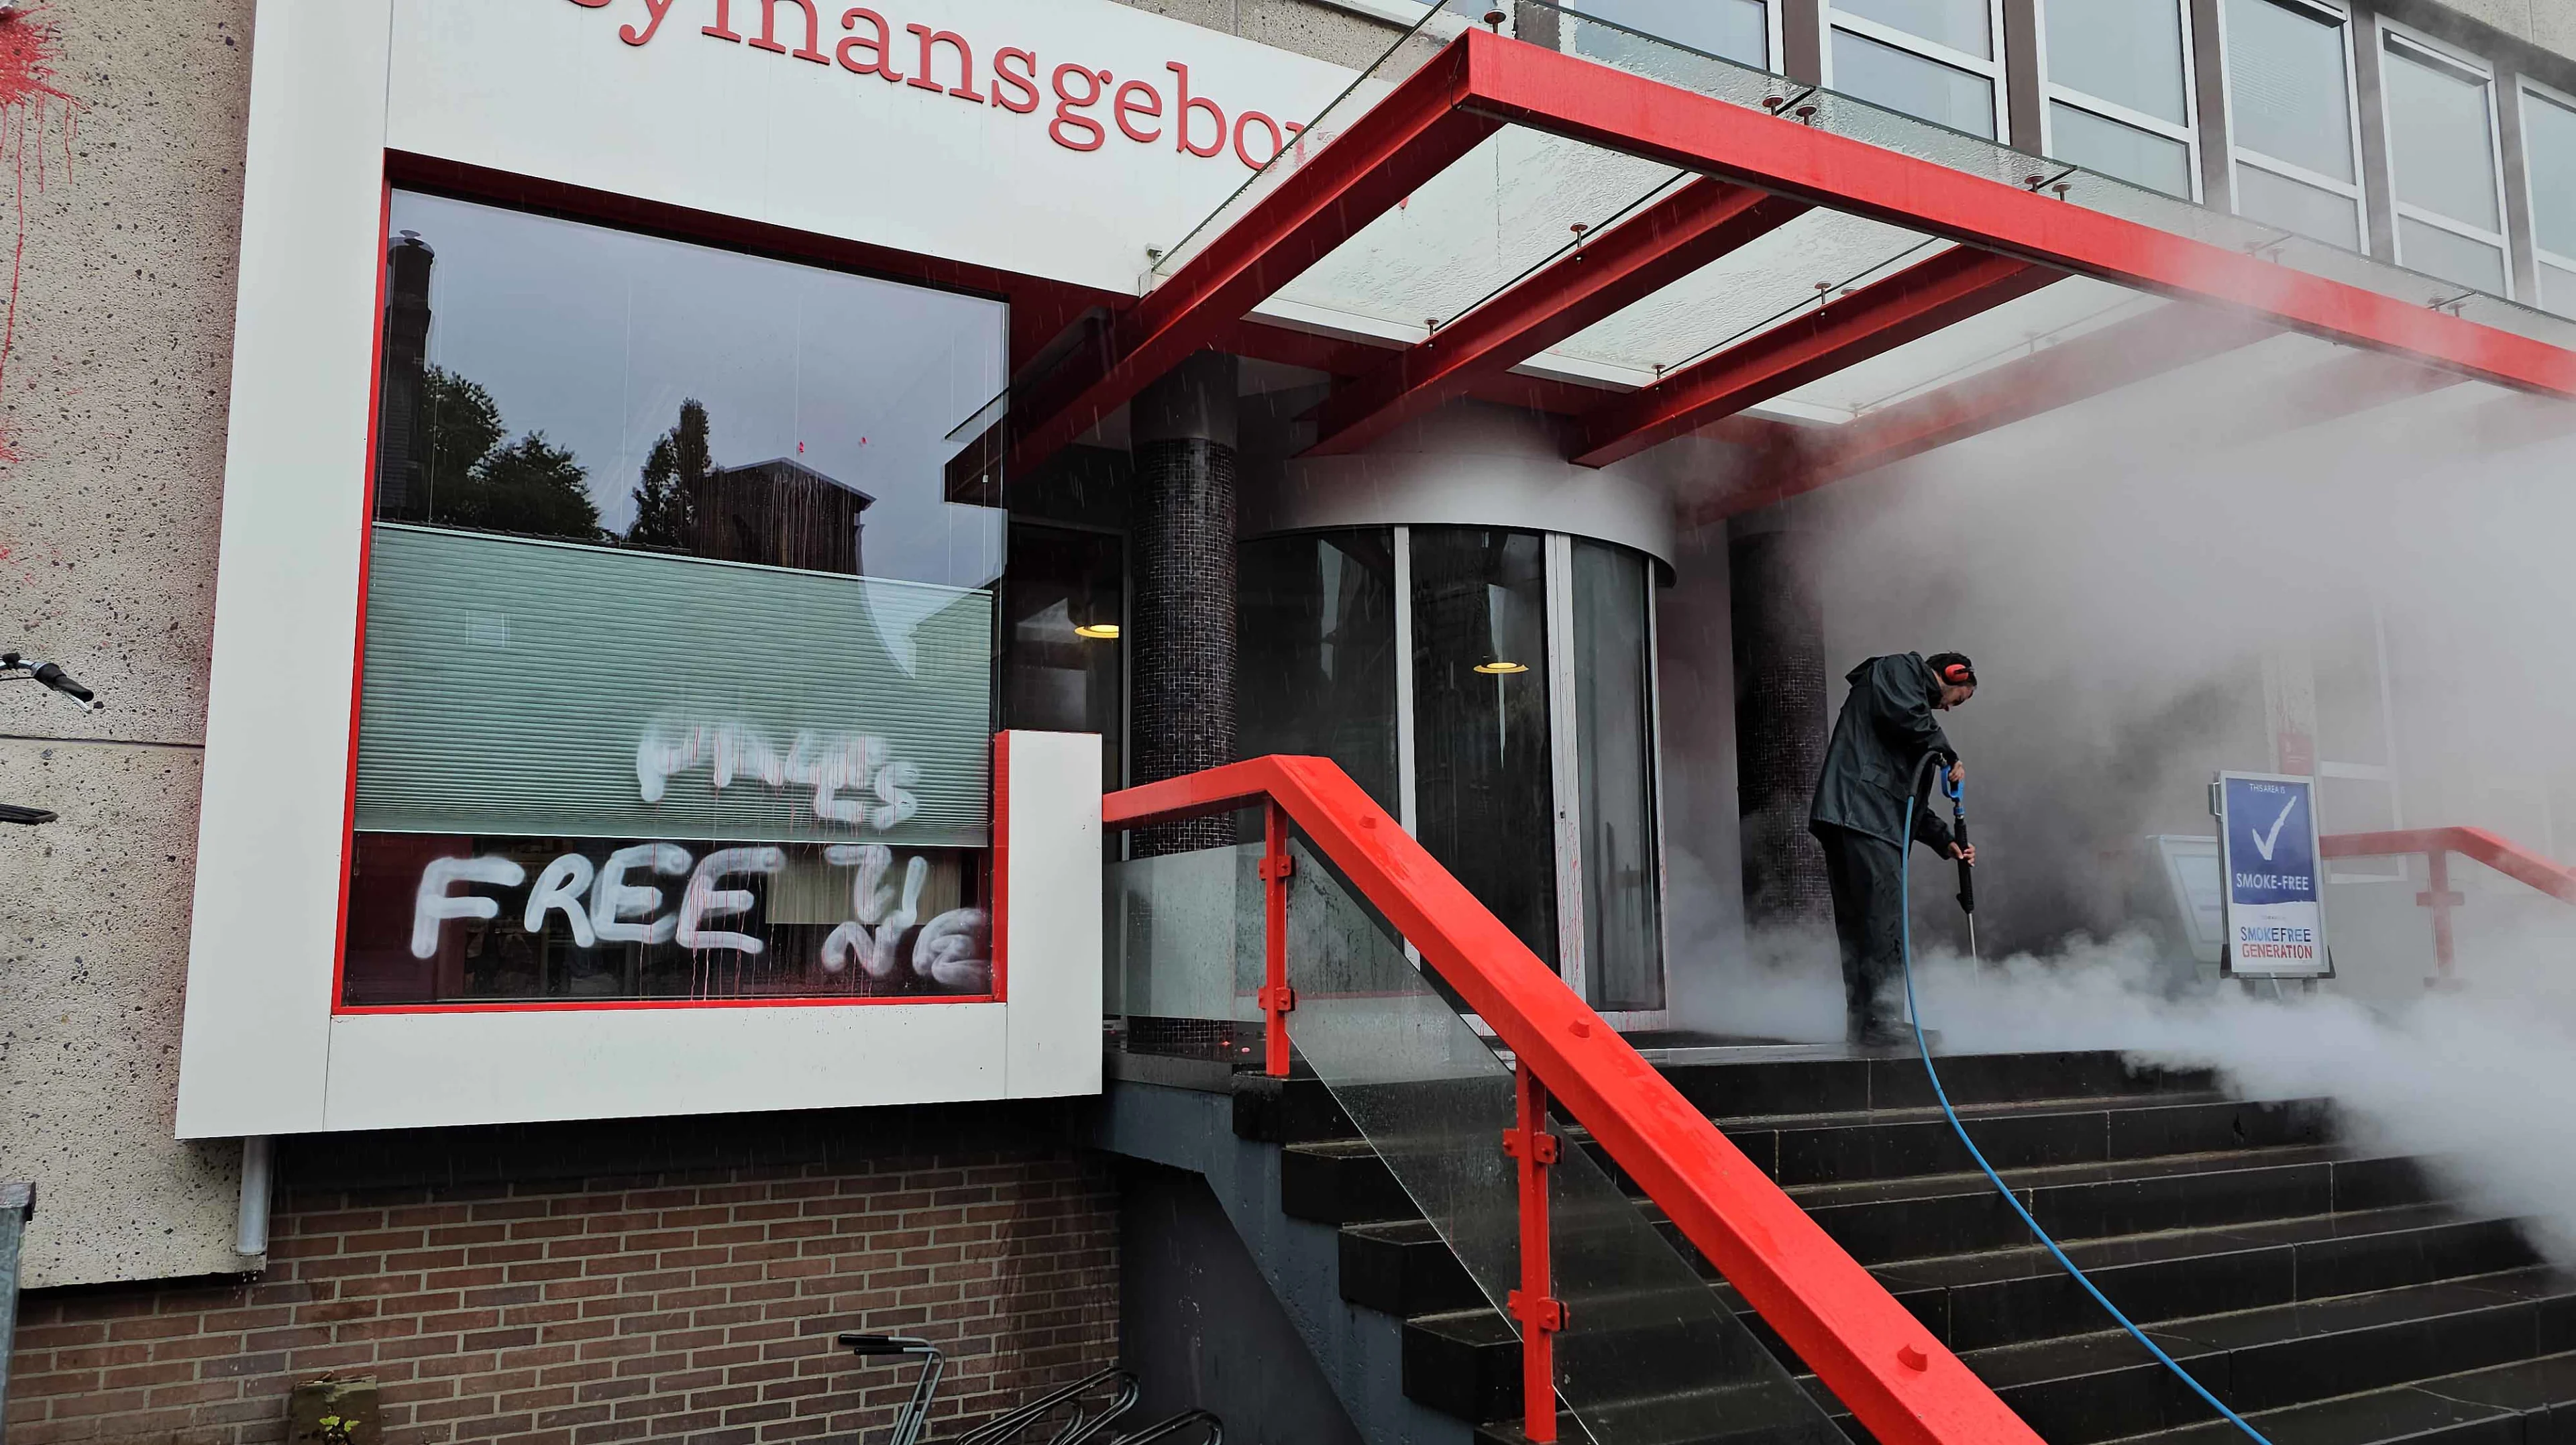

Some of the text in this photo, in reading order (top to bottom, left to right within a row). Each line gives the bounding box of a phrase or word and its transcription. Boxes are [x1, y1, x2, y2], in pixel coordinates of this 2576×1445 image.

[2249, 783, 2263, 792] THIS
[2263, 784, 2279, 794] AREA
[2236, 873, 2309, 891] SMOKE-FREE
[411, 843, 786, 959] FREE
[2241, 926, 2312, 943] SMOKEFREE
[2242, 943, 2313, 959] GENERATION
